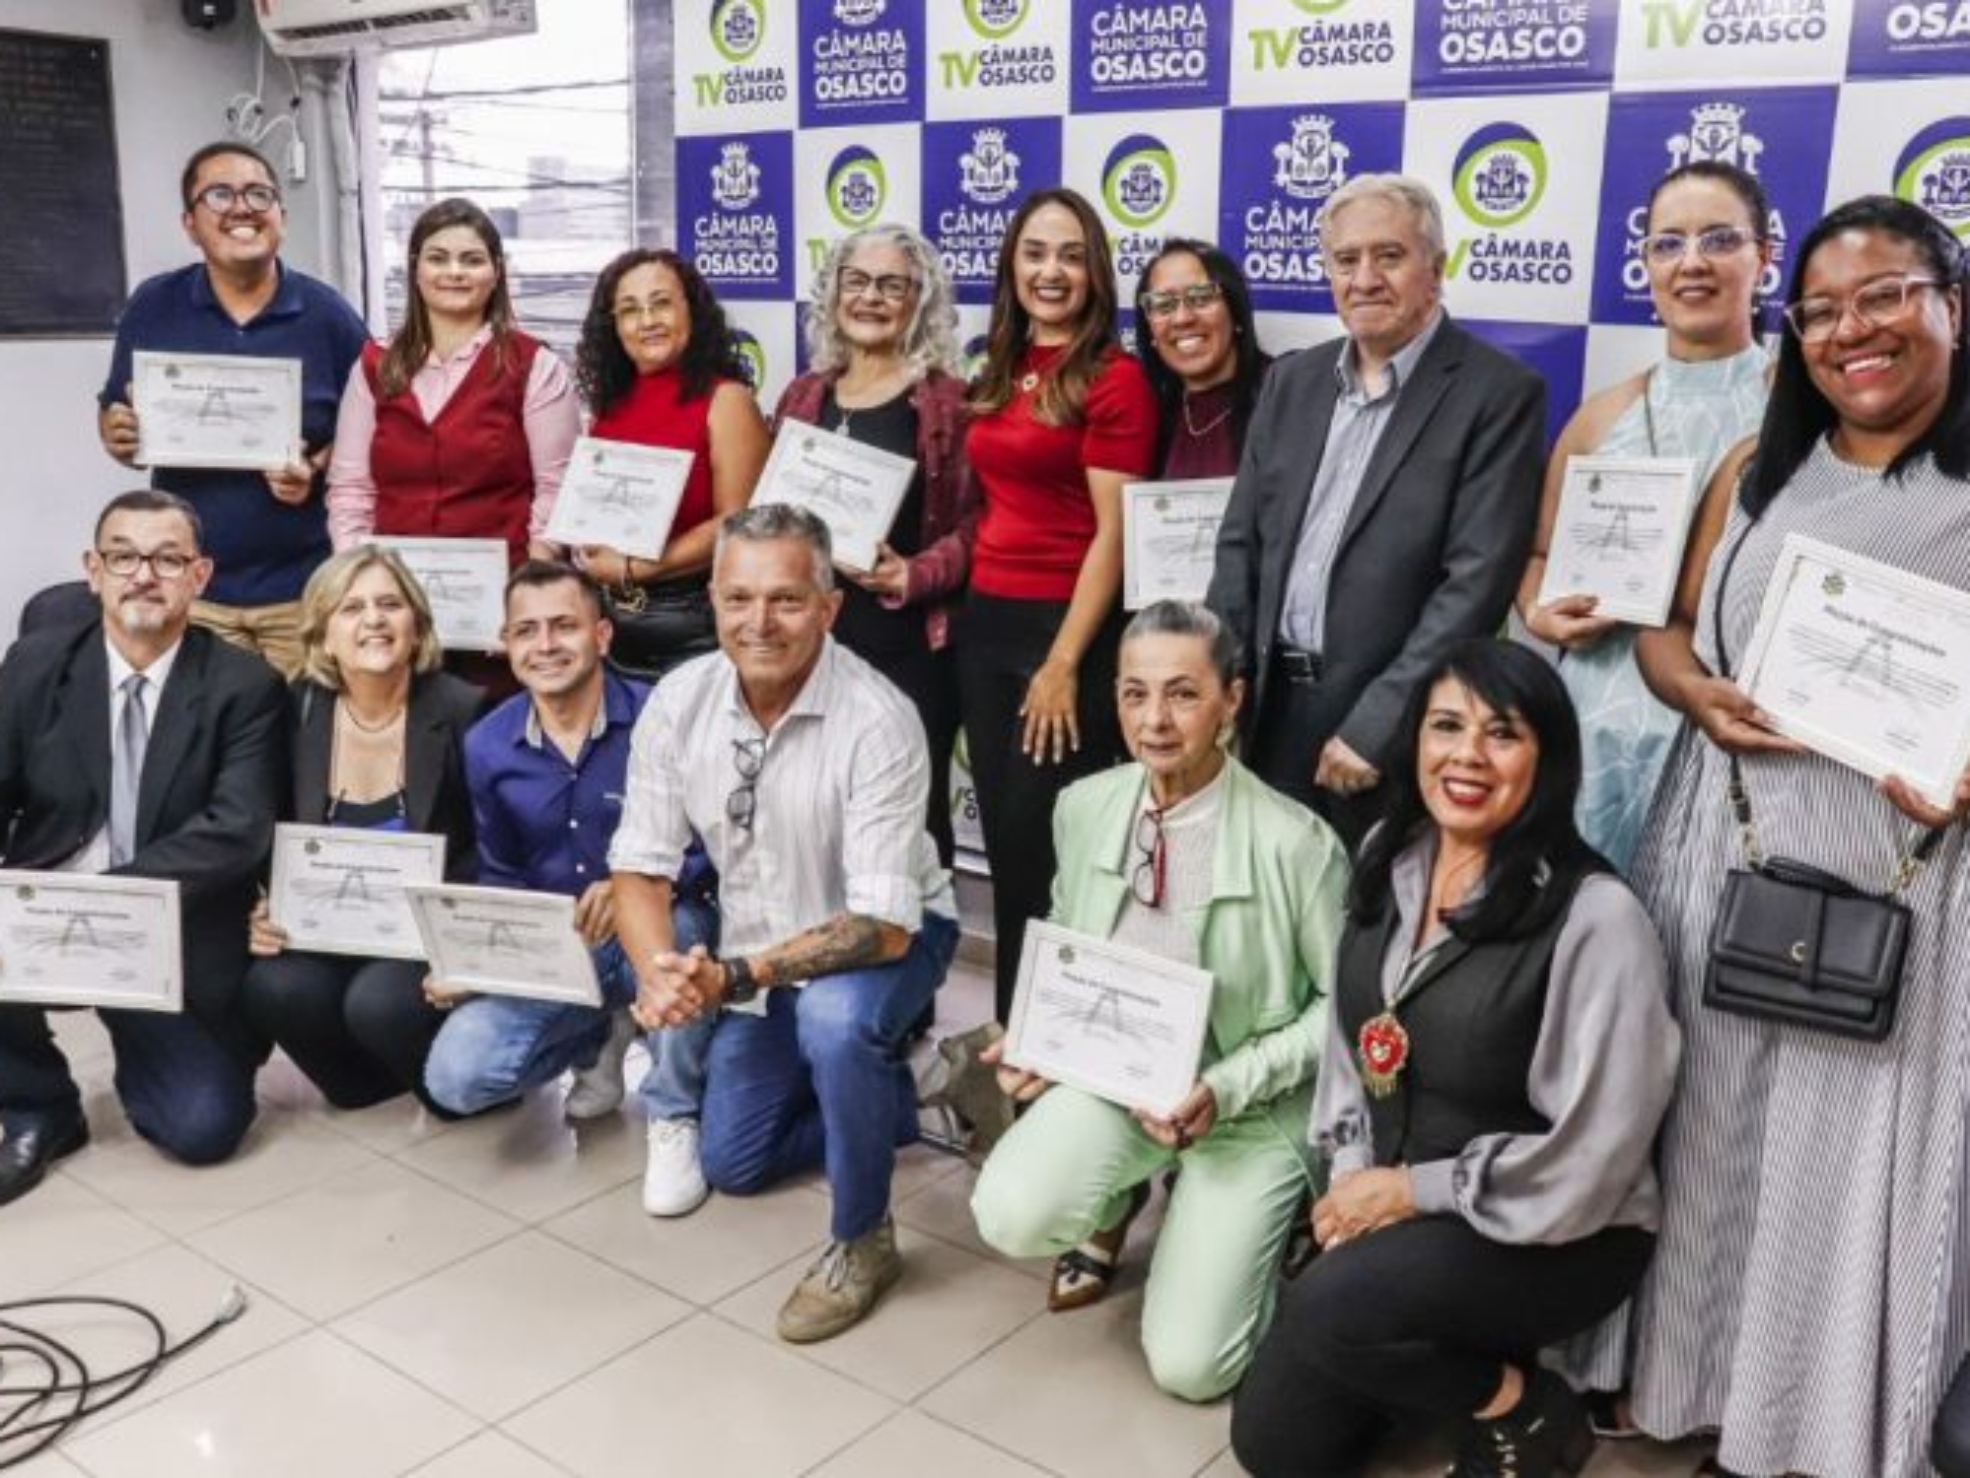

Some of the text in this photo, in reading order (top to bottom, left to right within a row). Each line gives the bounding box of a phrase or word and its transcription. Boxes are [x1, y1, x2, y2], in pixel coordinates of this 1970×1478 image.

[1091, 3, 1207, 37] CÂMARA
[1440, 7, 1553, 31] MUNICIPAL
[1557, 4, 1589, 23] DE
[1703, 17, 1827, 45] OSASCO
[813, 29, 906, 58] CÂMARA
[1091, 31, 1206, 54] MUNICIPAL DE
[1248, 20, 1392, 72] TV CÂMARA
[1298, 43, 1394, 68] OSASCO
[1438, 25, 1586, 63] OSASCO
[887, 53, 906, 69] DE
[939, 44, 1054, 89] TV CÂMARA
[1091, 50, 1206, 83] OSASCO
[692, 65, 785, 107] TV CÂMARA
[815, 71, 907, 100] OSASCO
[979, 64, 1056, 87] OSASCO
[724, 85, 787, 104] OSASCO
[694, 212, 778, 239] CÂMARA
[1469, 232, 1572, 261] CÂMARA
[695, 250, 779, 276] OSASCO
[1468, 260, 1573, 285] OSASCO
